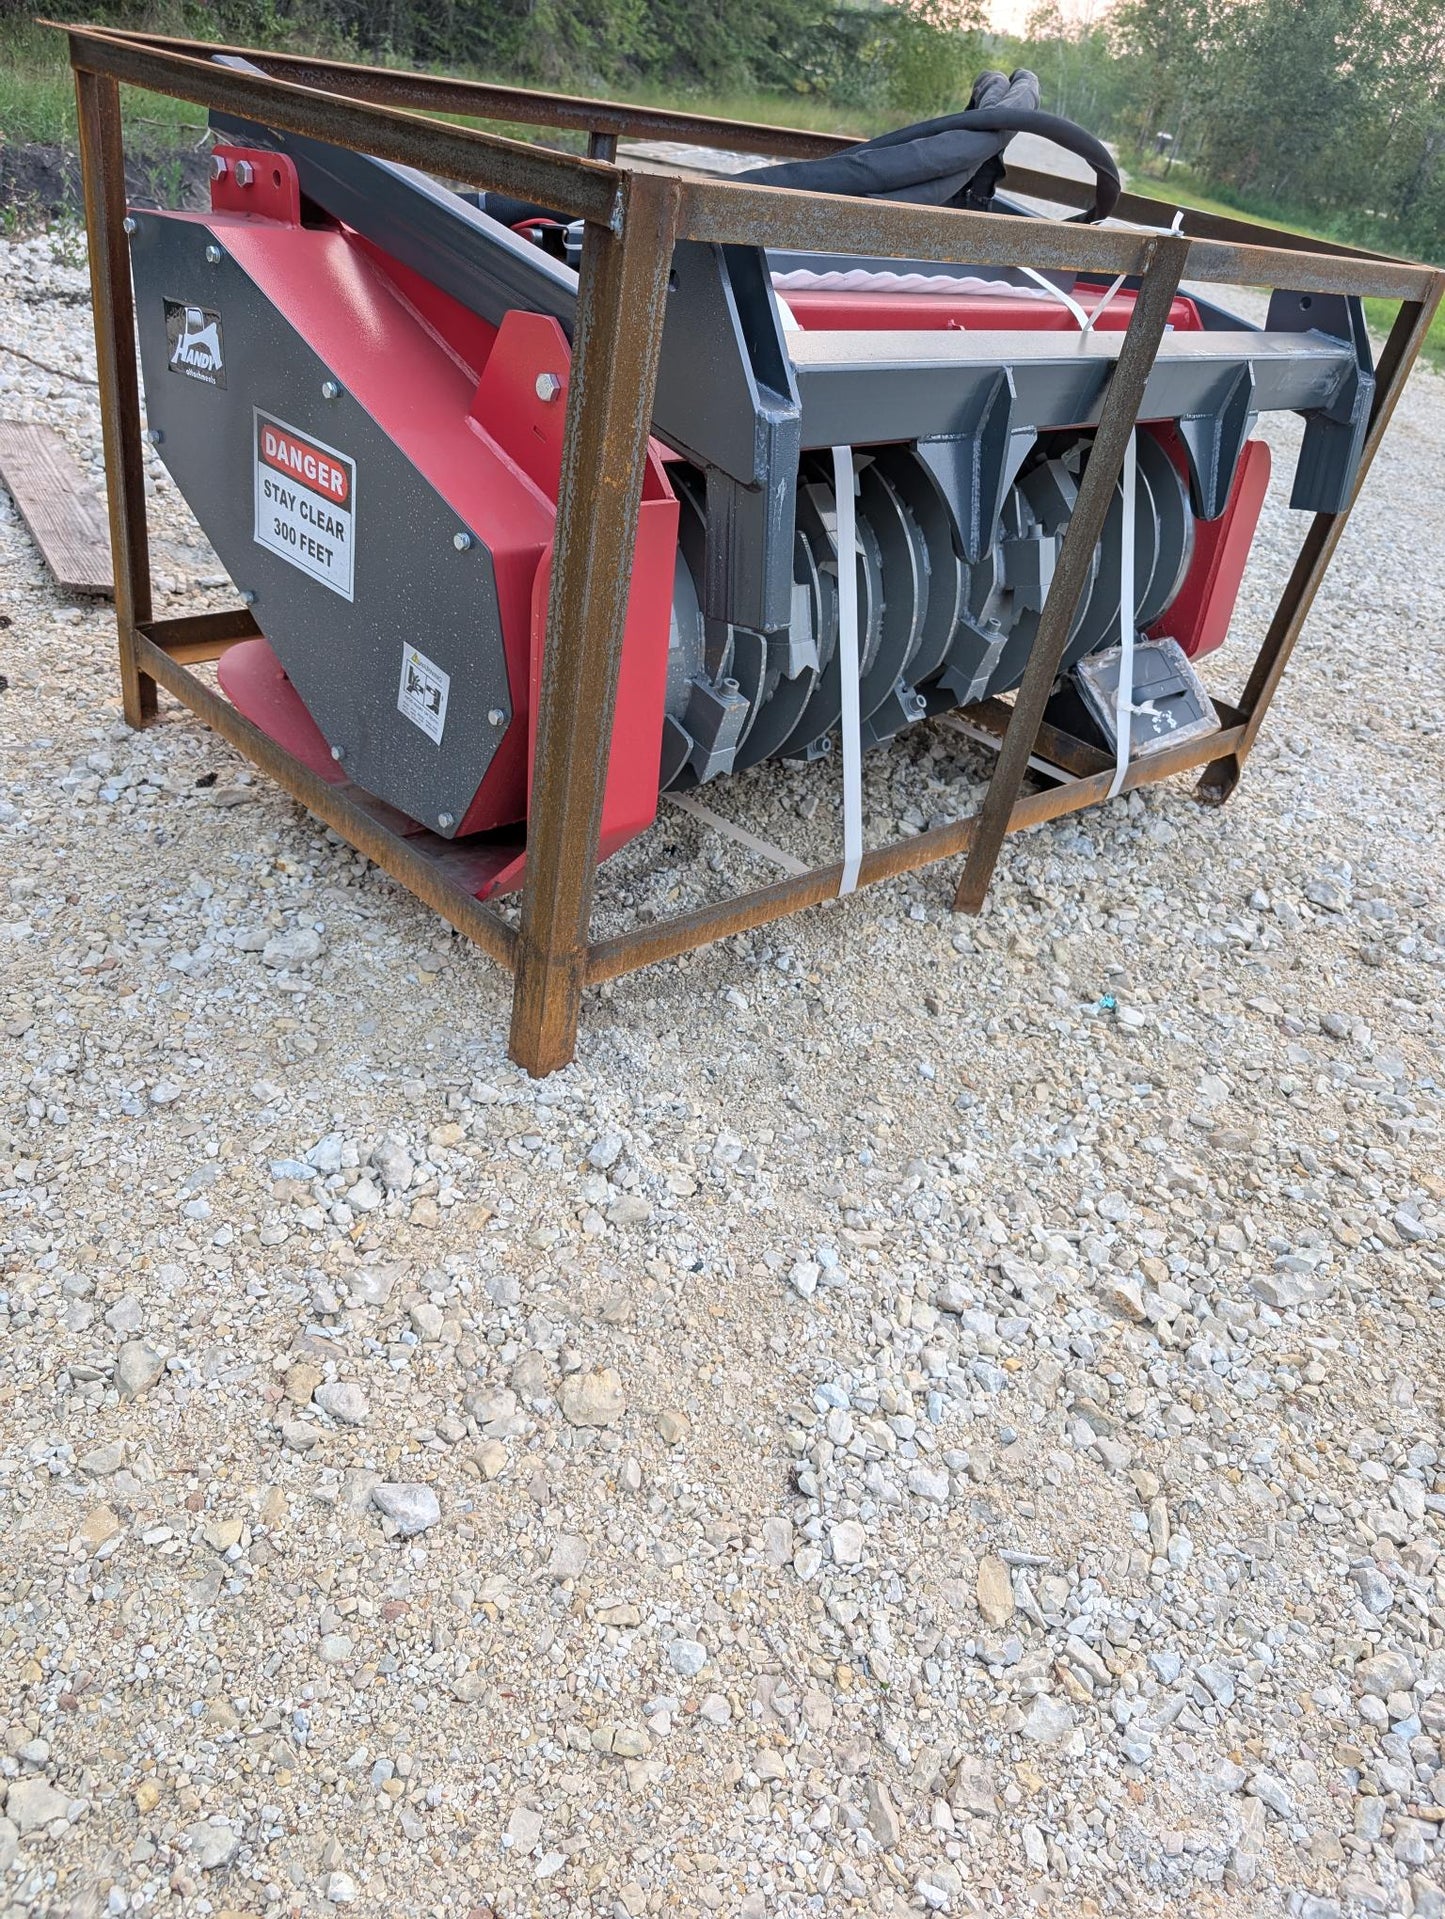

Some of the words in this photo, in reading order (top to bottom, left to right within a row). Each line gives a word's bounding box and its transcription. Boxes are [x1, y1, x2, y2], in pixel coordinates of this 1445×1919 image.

[170, 332, 223, 371] HANDY
[185, 368, 216, 385] attachments
[265, 432, 344, 497] DANGER
[263, 479, 297, 512] STAY
[299, 500, 345, 543] CLEAR
[273, 517, 297, 545] 300
[299, 532, 334, 568] FEET
